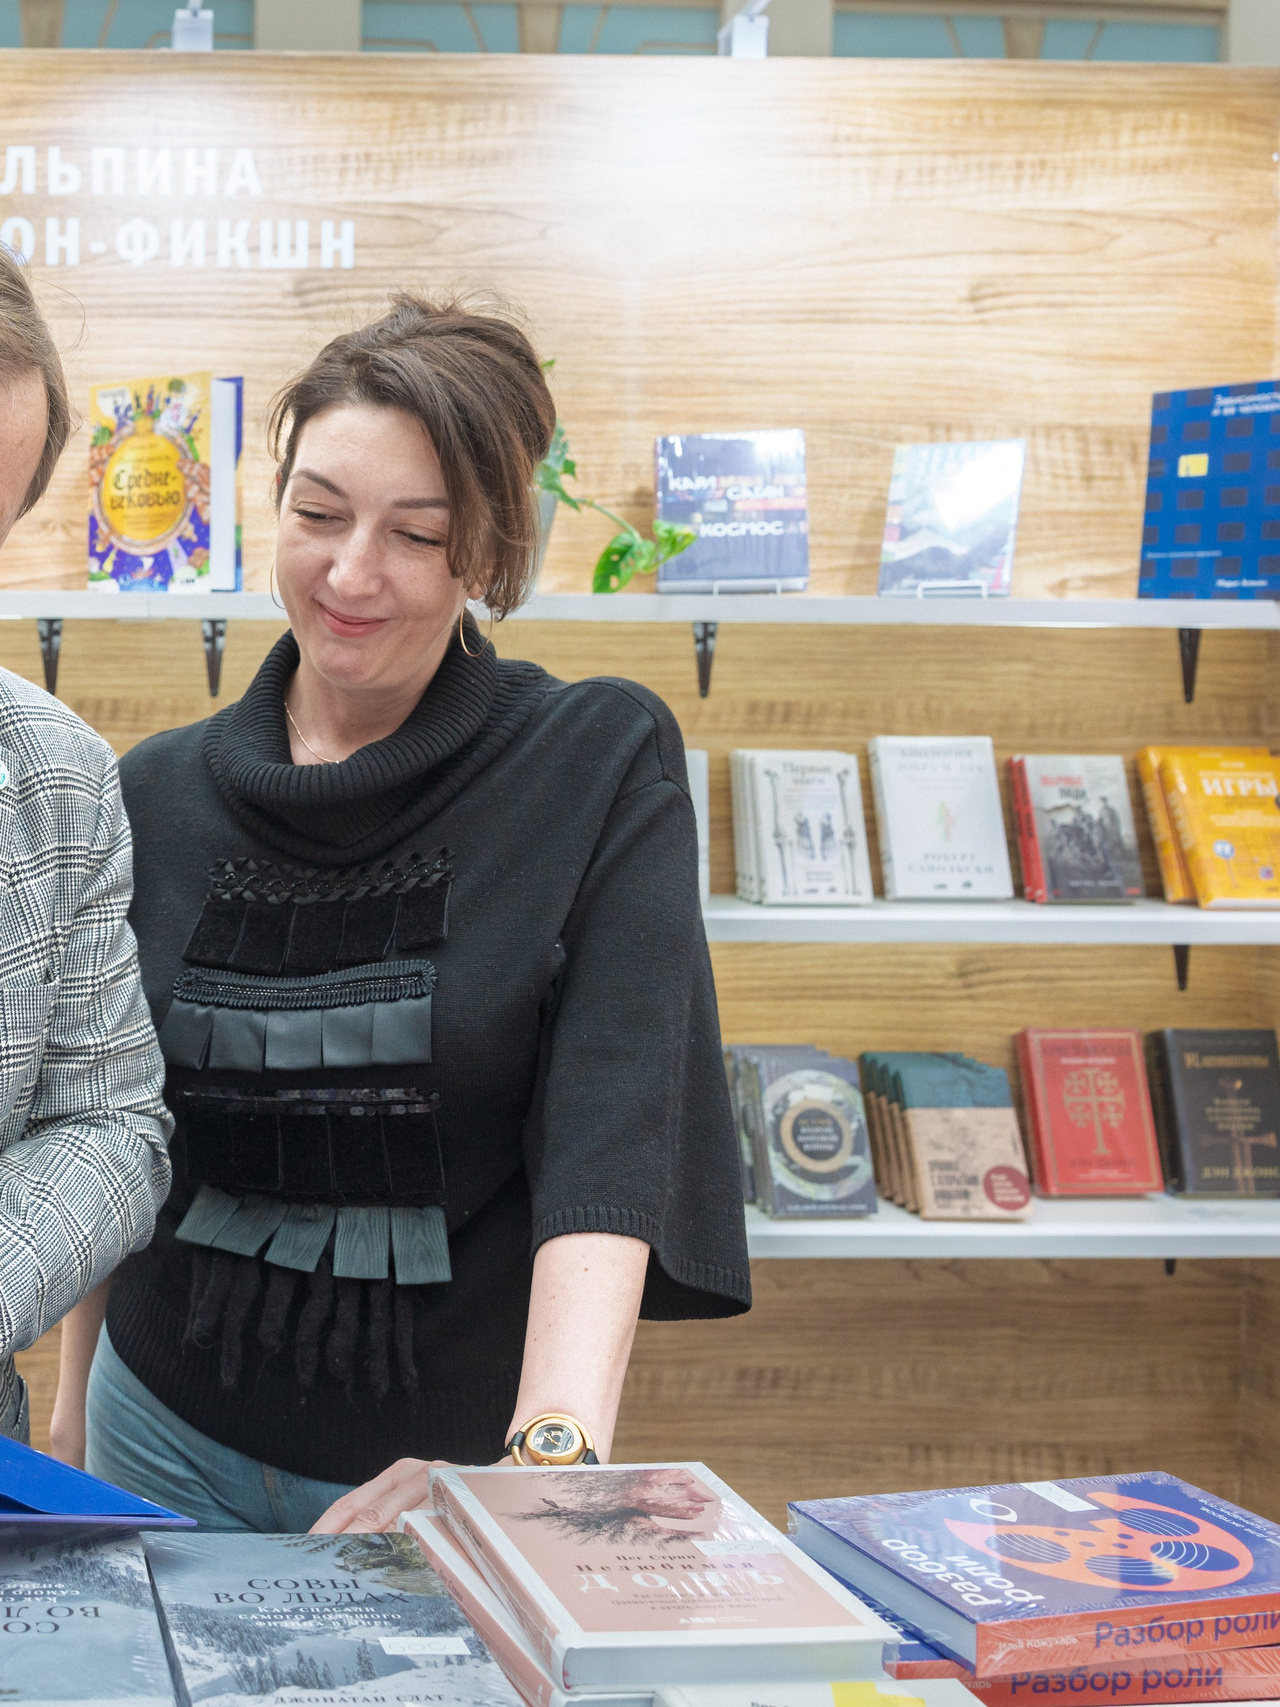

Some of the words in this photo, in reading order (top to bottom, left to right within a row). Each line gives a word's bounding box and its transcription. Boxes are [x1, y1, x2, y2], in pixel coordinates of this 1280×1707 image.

[699, 520, 785, 538] КОСМОС
[1201, 776, 1279, 797] ИГРЫ
[648, 1554, 696, 1562] Стрип
[573, 1561, 755, 1573] Нелюбимая
[881, 1538, 1003, 1607] Разбор
[246, 1578, 364, 1590] СОВЫ
[944, 1554, 1046, 1603] роли
[211, 1592, 266, 1604] ВО
[282, 1592, 411, 1606] ЛЬДАХ
[46, 1605, 102, 1619] ВО
[1095, 1615, 1204, 1650] Разбор
[998, 1639, 1024, 1652] Илья
[1026, 1635, 1078, 1649] Кожухарь
[963, 1680, 993, 1690] харь
[1011, 1666, 1132, 1696] Разбор
[1142, 1666, 1224, 1695] роли
[273, 1695, 387, 1704] ДЖОНАТАН
[395, 1694, 445, 1702] СЛАТ
